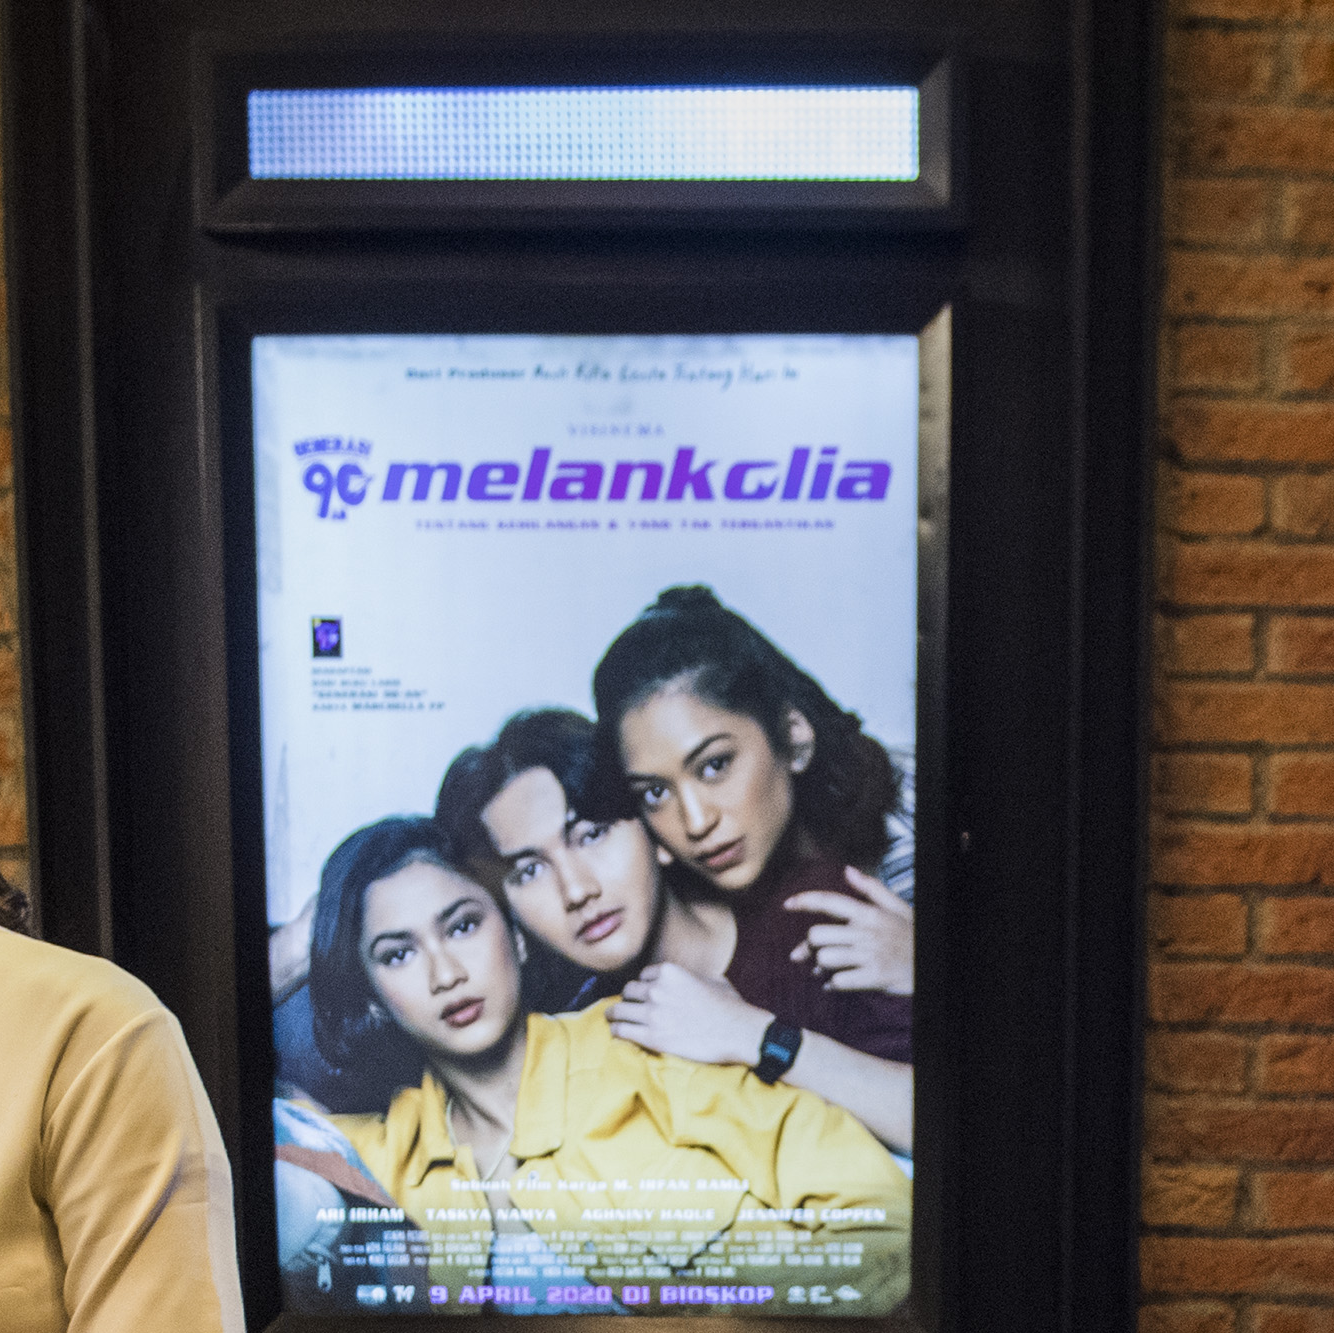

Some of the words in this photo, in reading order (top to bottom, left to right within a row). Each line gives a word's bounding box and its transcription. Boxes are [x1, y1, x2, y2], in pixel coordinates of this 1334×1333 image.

[380, 445, 893, 501] melankolia
[316, 1207, 346, 1222] ARI
[349, 1207, 405, 1222] IRHAM
[425, 1207, 491, 1222] TASKYA
[496, 1207, 557, 1222] NAMYA
[736, 1207, 815, 1222] JENNIFER
[820, 1207, 886, 1222] COPPEN
[429, 1285, 449, 1304] 9
[459, 1285, 537, 1304] APRIL
[546, 1285, 612, 1304] 2020
[660, 1285, 774, 1304] BIOSKOP
